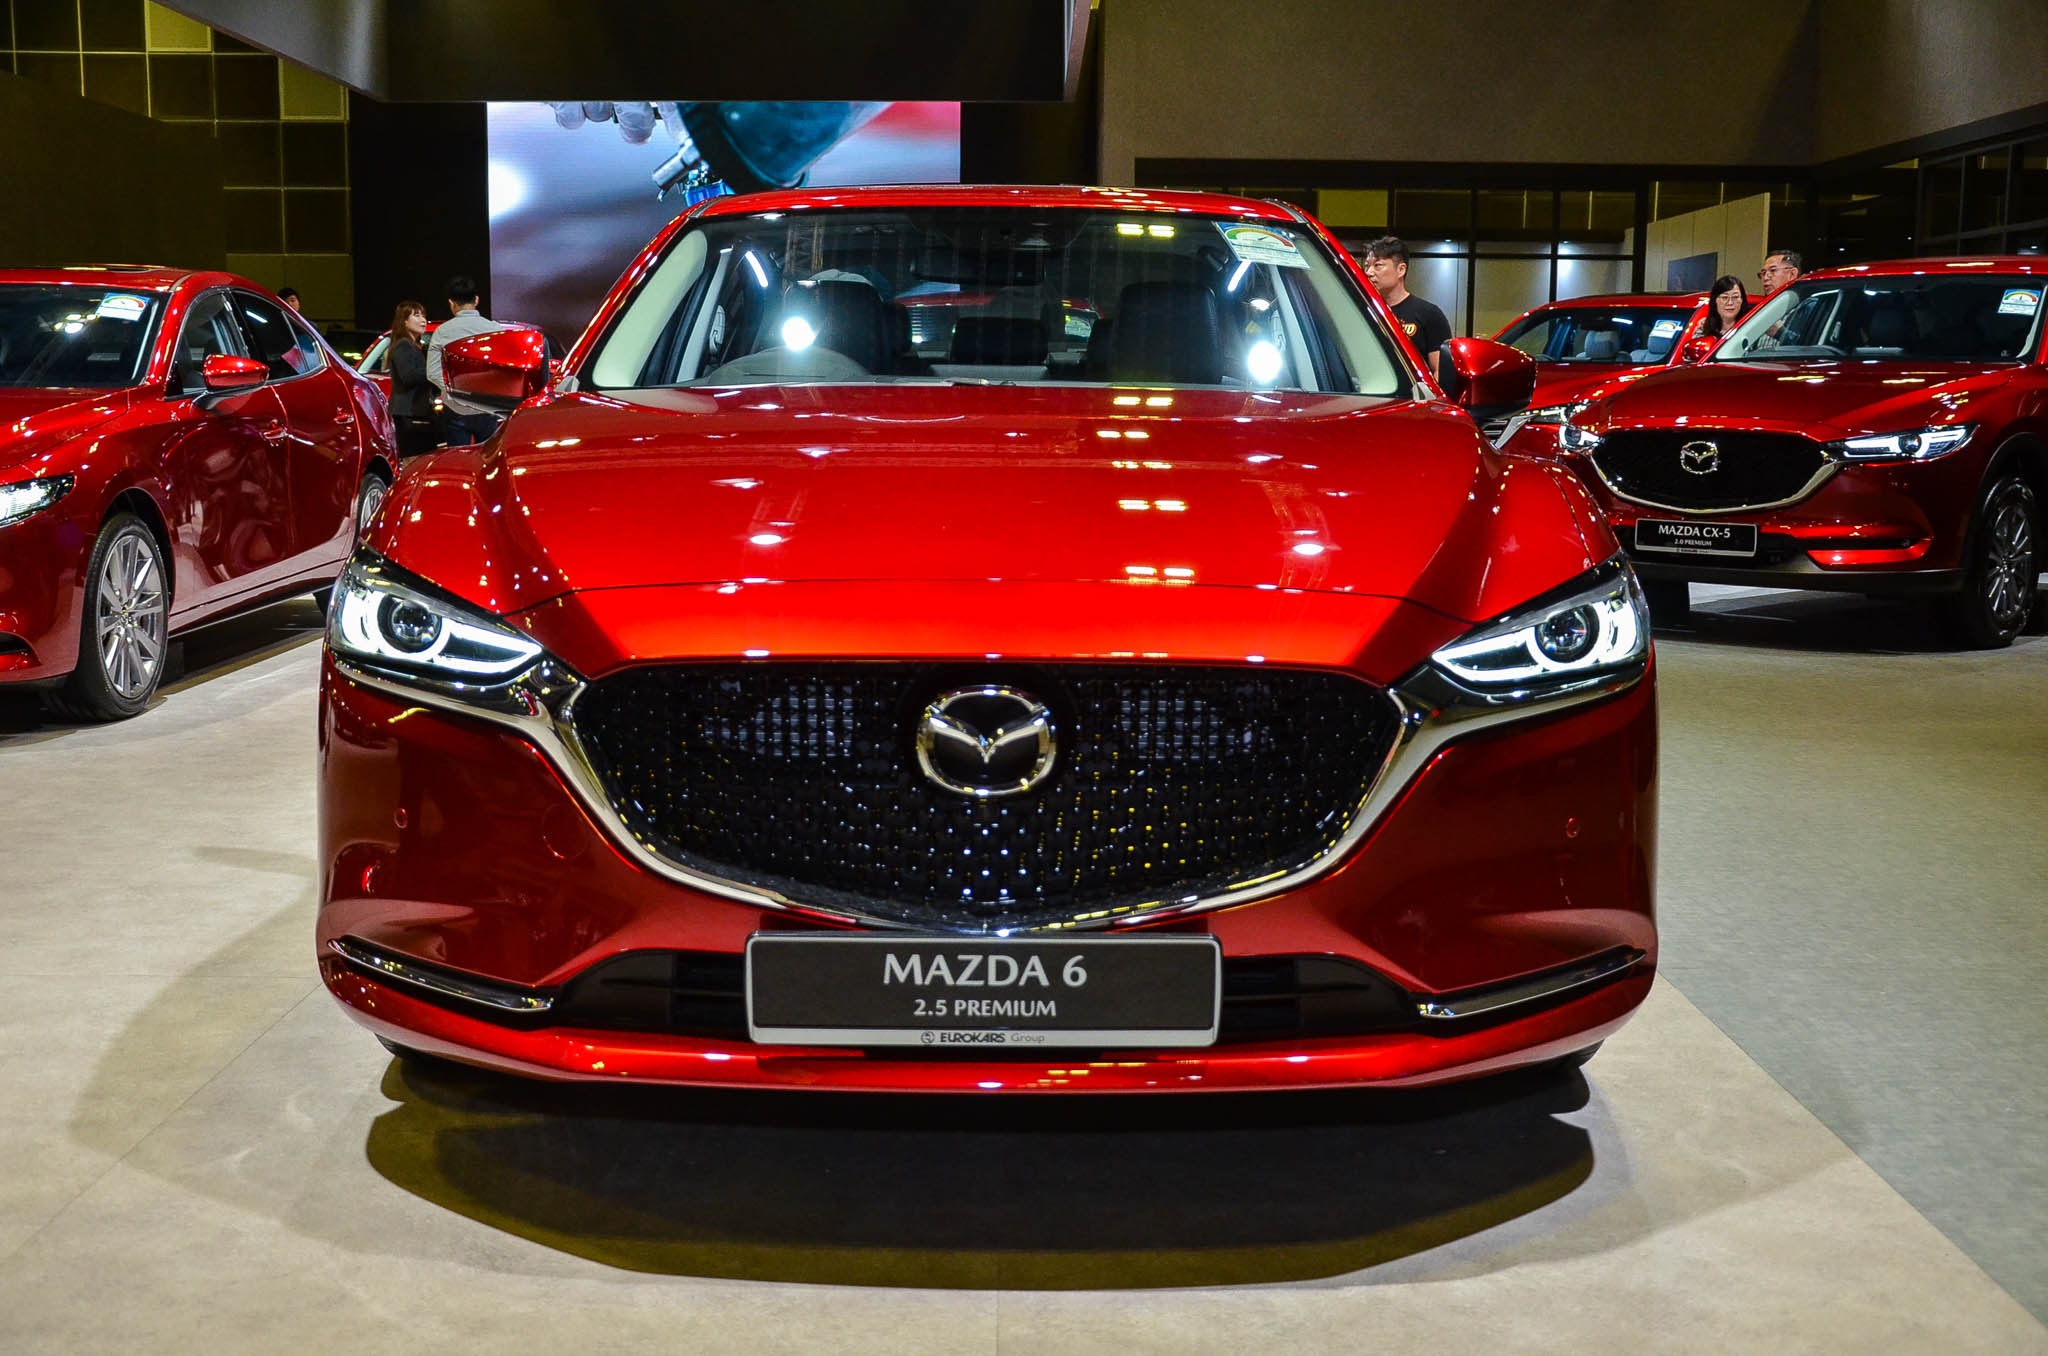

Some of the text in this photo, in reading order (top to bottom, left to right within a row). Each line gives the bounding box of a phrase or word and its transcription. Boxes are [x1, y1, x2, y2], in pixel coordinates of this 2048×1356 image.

[1658, 524, 1731, 538] MAZDA CX-5
[883, 953, 1088, 988] MAZDA 6
[913, 999, 1057, 1017] 2.5 PREMIUM
[940, 1032, 1045, 1044] EUROKARS Group
